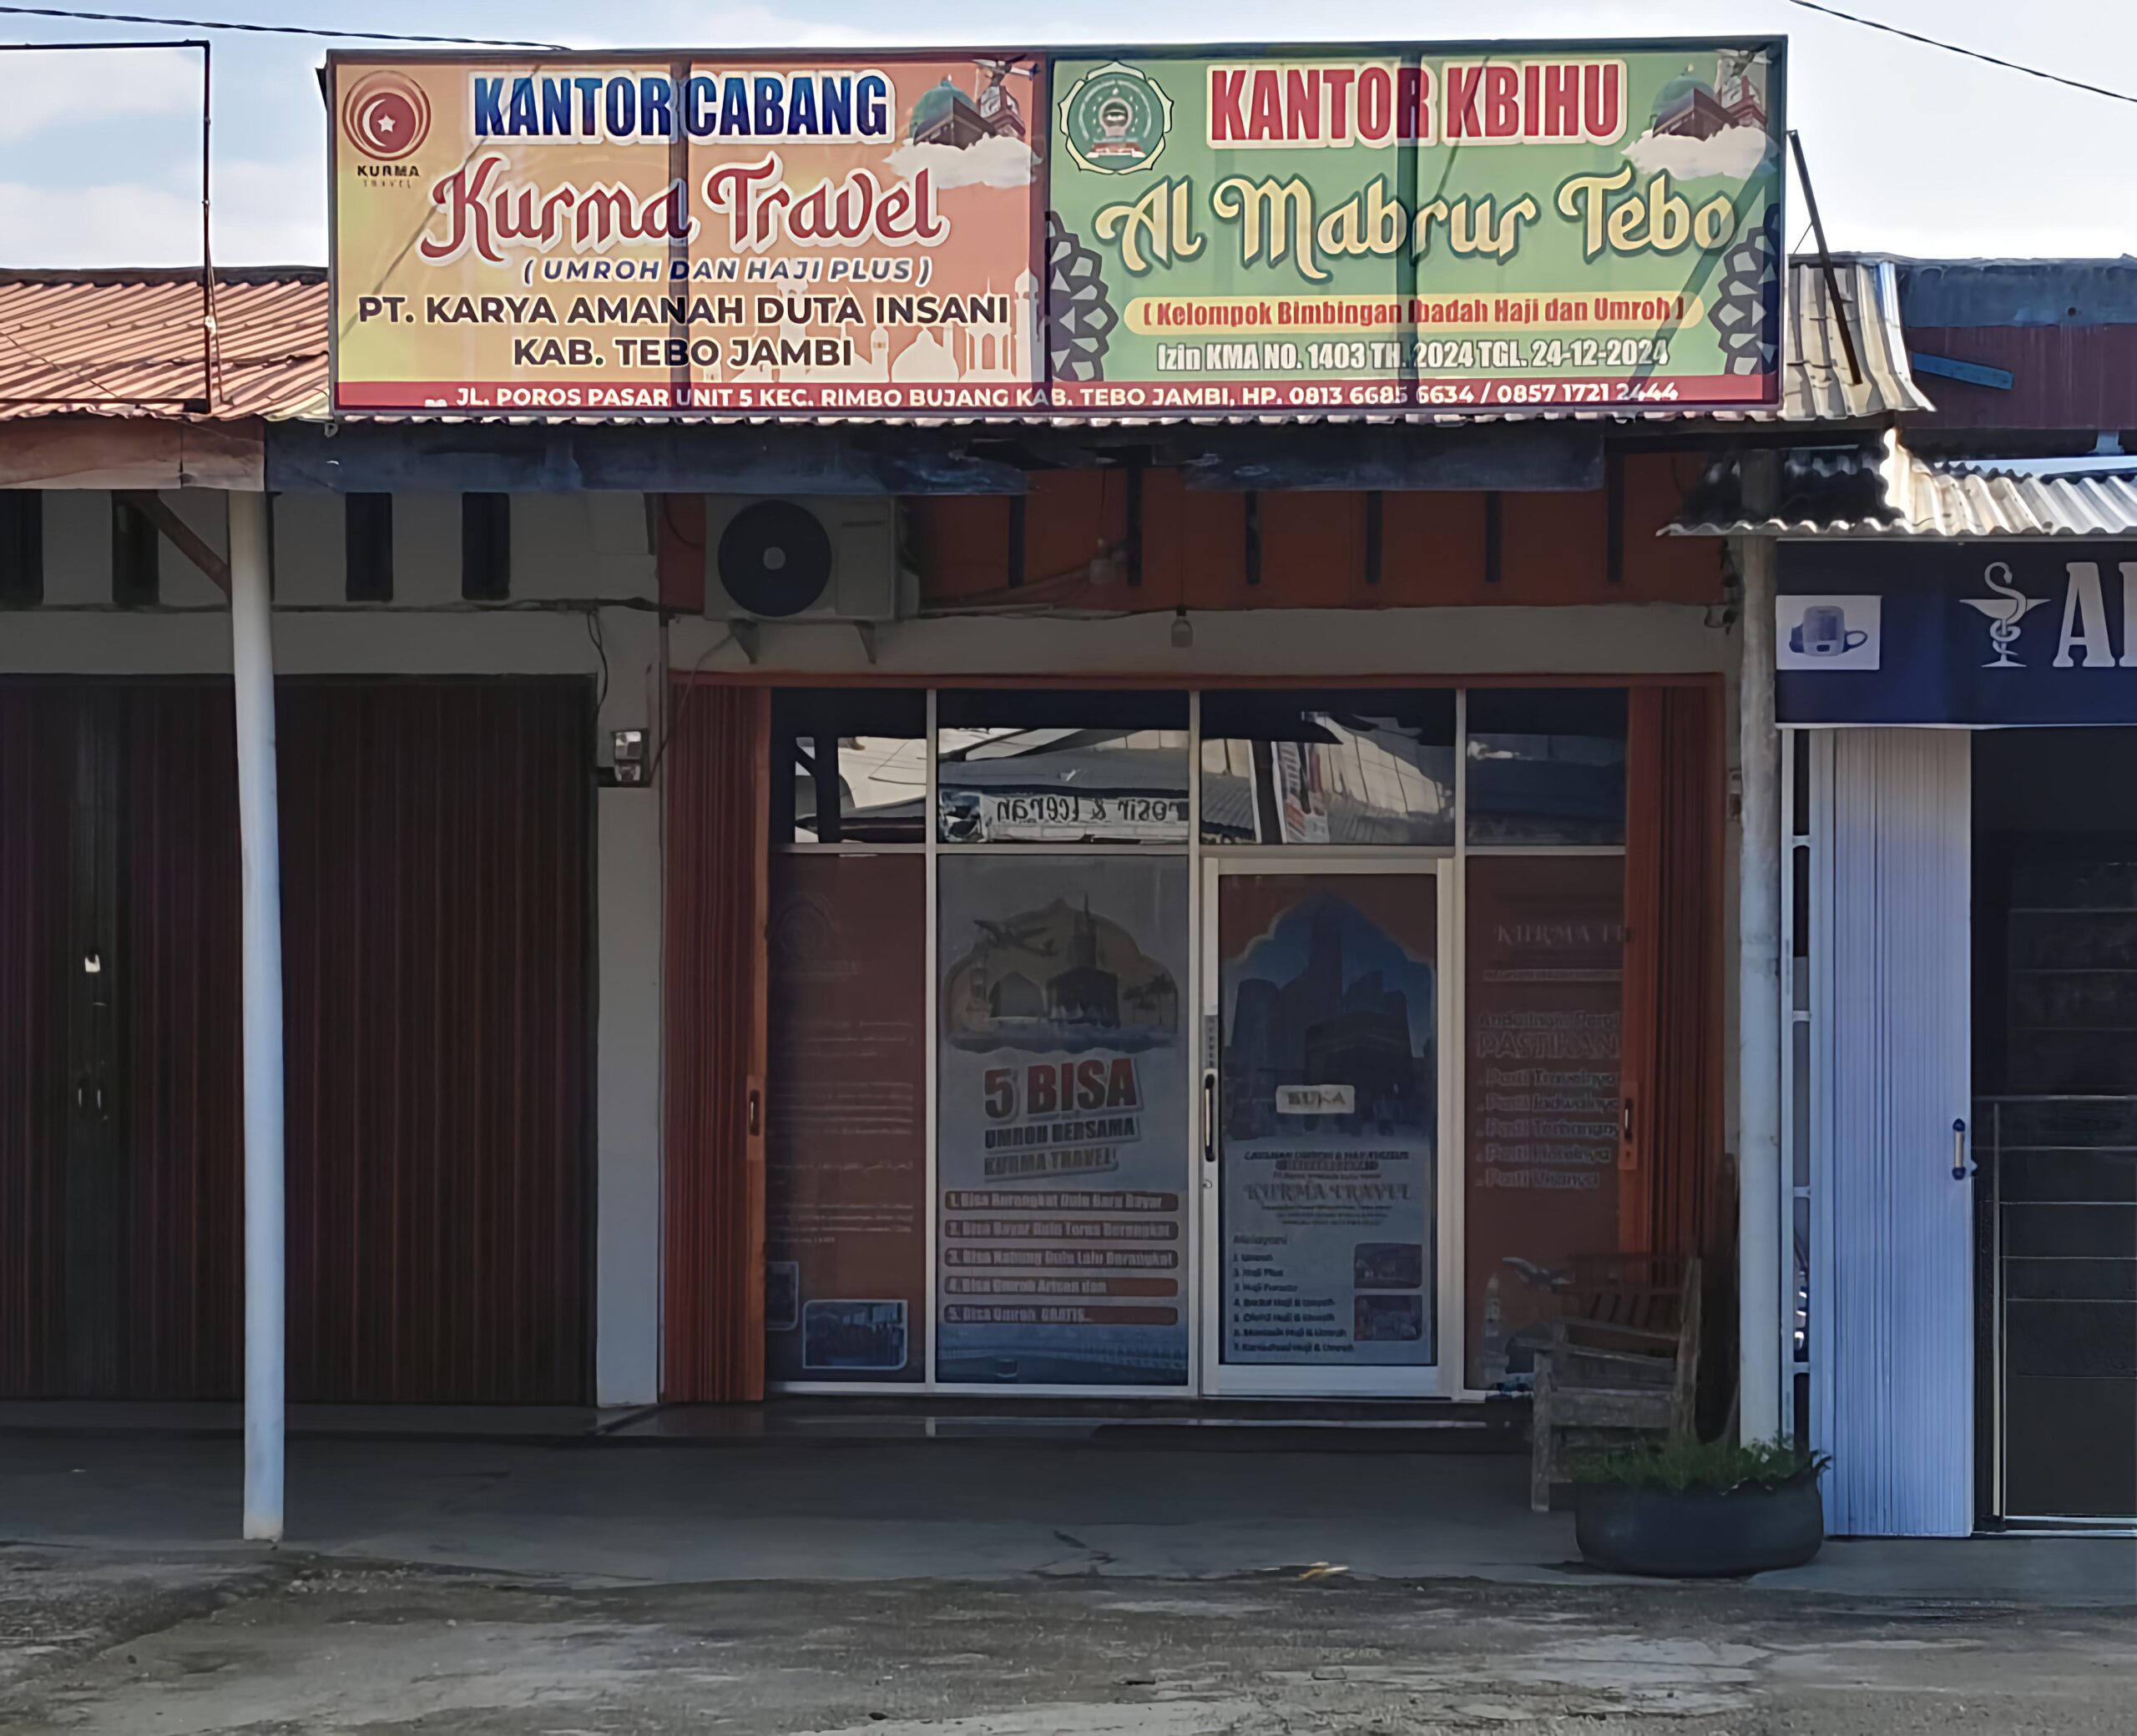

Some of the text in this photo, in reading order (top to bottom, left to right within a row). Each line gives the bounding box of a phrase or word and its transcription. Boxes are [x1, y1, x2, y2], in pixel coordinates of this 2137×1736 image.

[474, 74, 887, 137] KANTOR CABANG
[1211, 63, 1619, 141] KANTOR KBIHU
[357, 165, 420, 177] KURMA
[420, 156, 942, 262] Kurma Travel
[1094, 165, 1735, 280] Al Mabrur Tebo
[670, 260, 736, 280] DAN
[748, 260, 821, 281] HAJI
[359, 296, 1008, 325] PT. KARYA AMANAH DUTA INSANI
[1494, 298, 1538, 325] Haji
[1544, 297, 1586, 322] dan
[514, 339, 851, 366] KAB. TEBO JAMBI
[1158, 338, 1670, 371] Izin KMA NO. 1403 TH. 2024 TGL. 24-12-2024
[456, 381, 1680, 407] JL. POROS PASAR UNIT 5 KEC. RIMBO BUJANG KAB. TEBO JAMBI, HP. 0813 6685 6634 / 0857 1721 2444
[983, 1057, 1138, 1119] 5 BISA
[1052, 1117, 1135, 1143] BERSAMA
